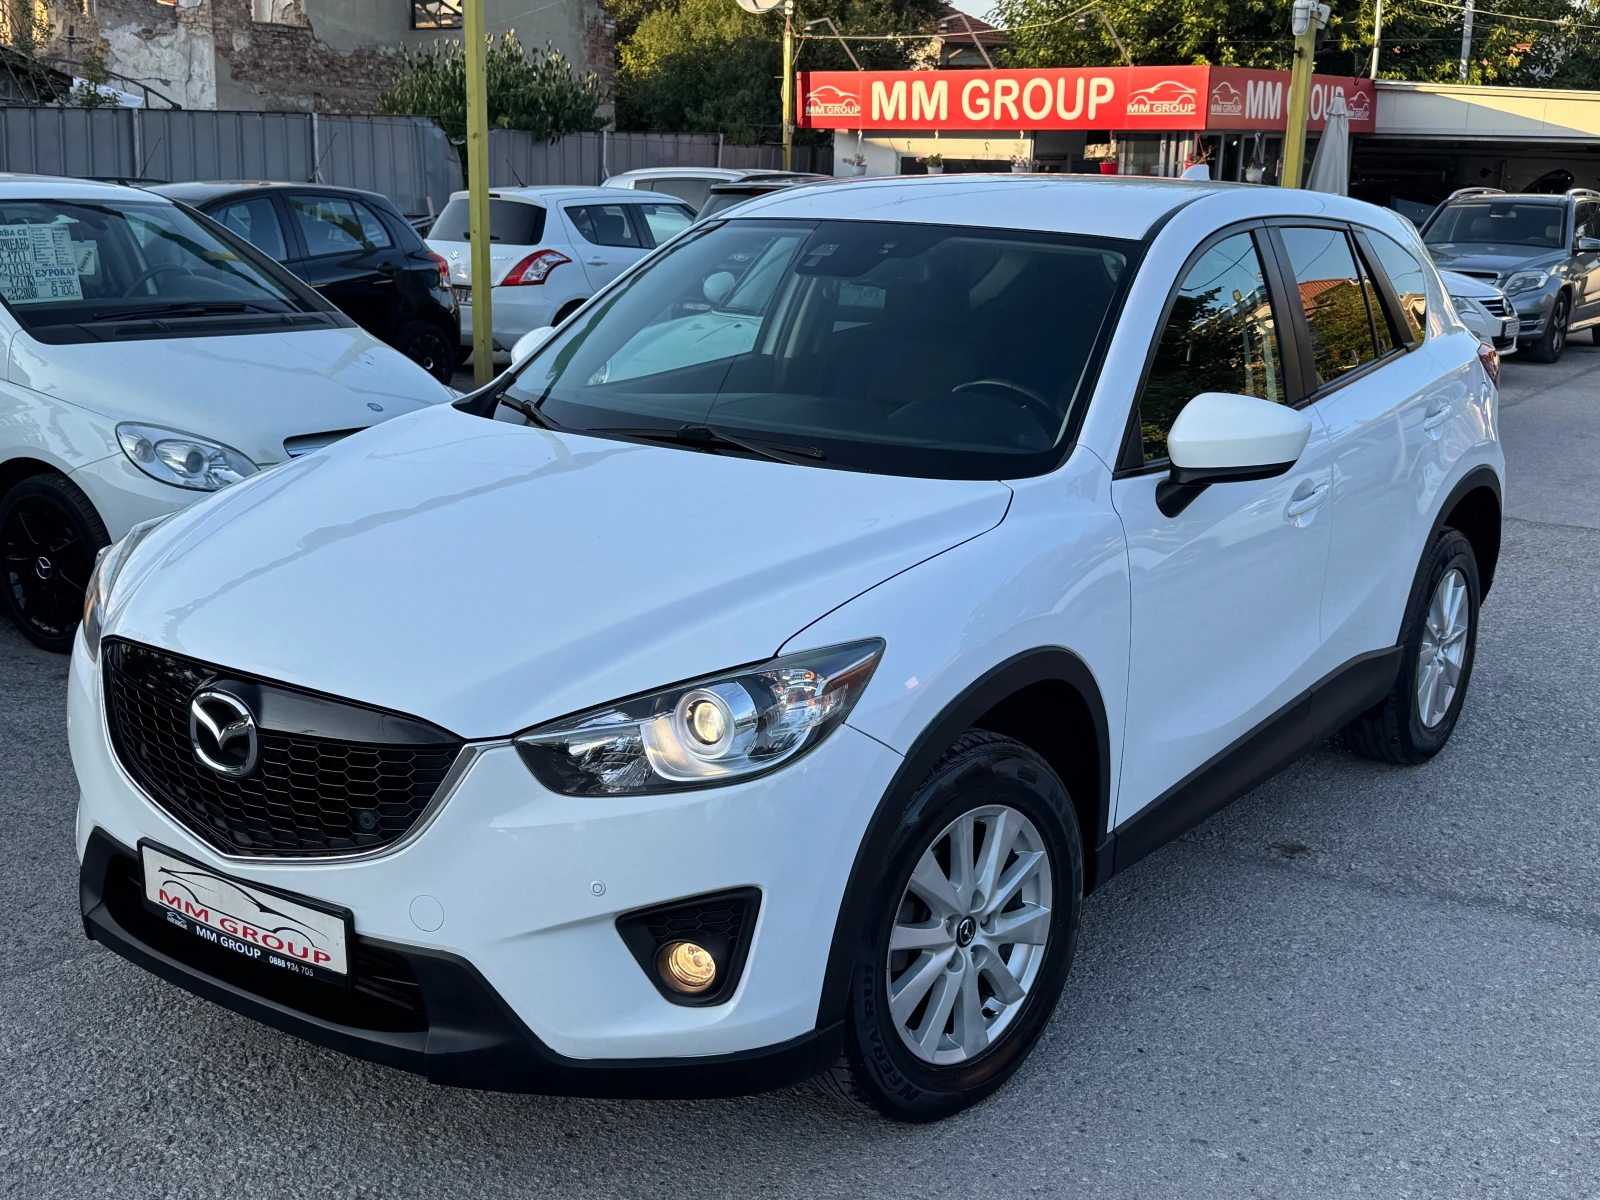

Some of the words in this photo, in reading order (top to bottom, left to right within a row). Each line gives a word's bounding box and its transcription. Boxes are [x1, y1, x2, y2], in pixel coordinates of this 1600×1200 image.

[806, 106, 824, 114] MM
[826, 106, 861, 114] GROUP
[871, 80, 948, 121] MM
[961, 77, 1115, 121] GROUP
[1127, 104, 1150, 113] MM
[1153, 103, 1196, 113] GROUP
[1211, 104, 1222, 113] MM
[1223, 104, 1242, 114] GROUP
[1245, 80, 1283, 120] MM
[35, 268, 76, 277] ЕУРОКАР
[159, 888, 209, 922] MM
[219, 918, 331, 963] GROUP
[196, 925, 218, 943] MM
[220, 936, 261, 959] GROUP
[269, 955, 286, 967] 0888
[286, 961, 299, 972] 936
[300, 965, 314, 977] 705
